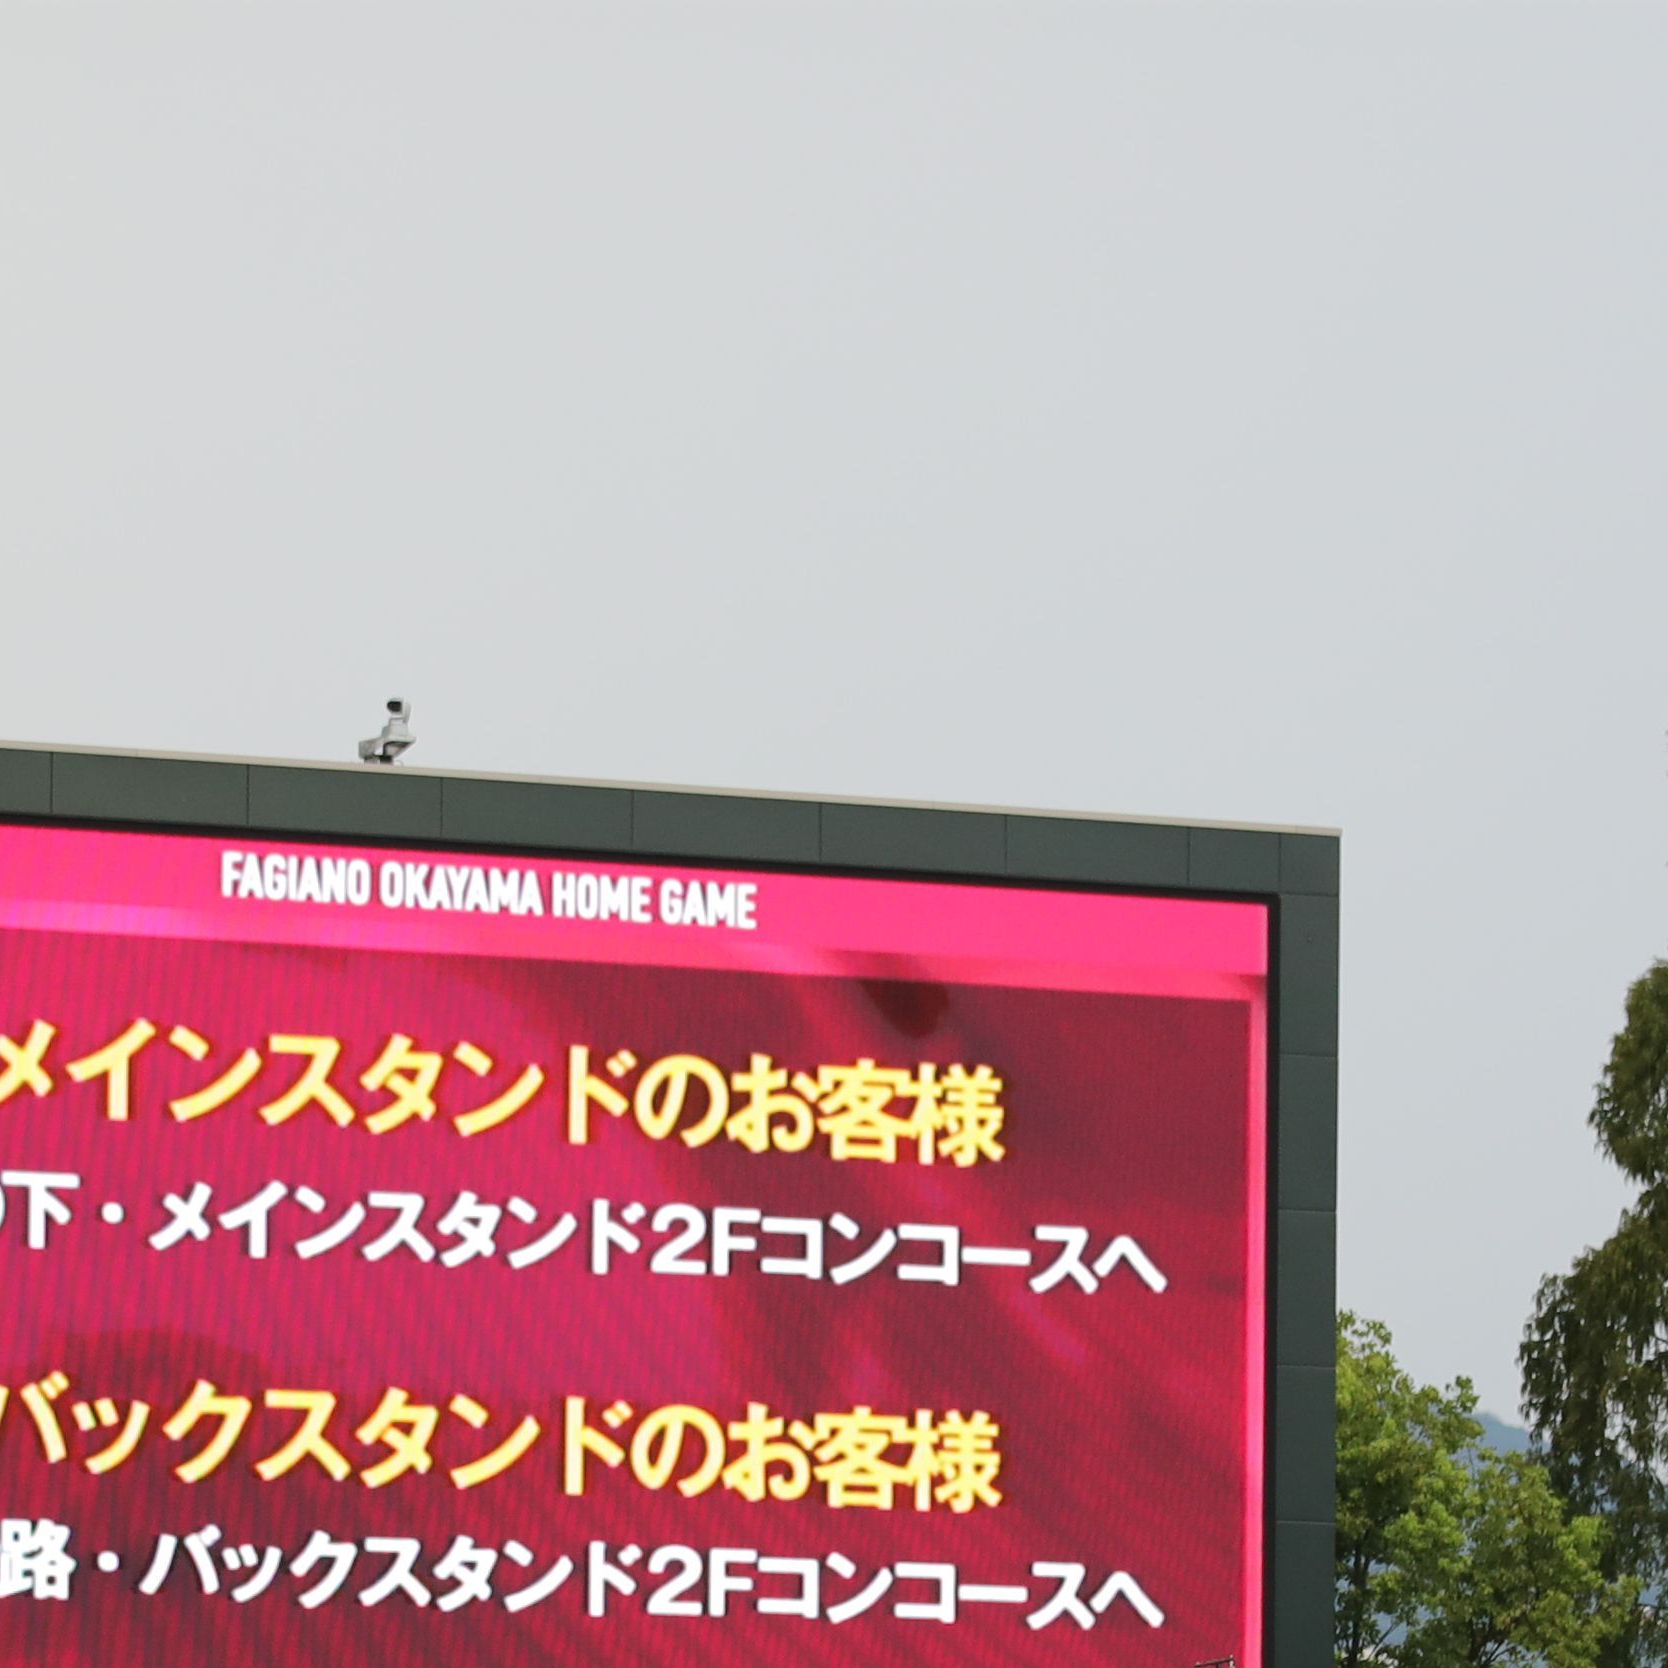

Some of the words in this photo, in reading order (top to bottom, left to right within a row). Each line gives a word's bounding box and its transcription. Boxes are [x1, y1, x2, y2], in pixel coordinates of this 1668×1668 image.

[220, 849, 372, 905] FAGIANO
[379, 859, 545, 917] OKAYAMA
[552, 869, 652, 924] HOME
[661, 878, 758, 931] GAME
